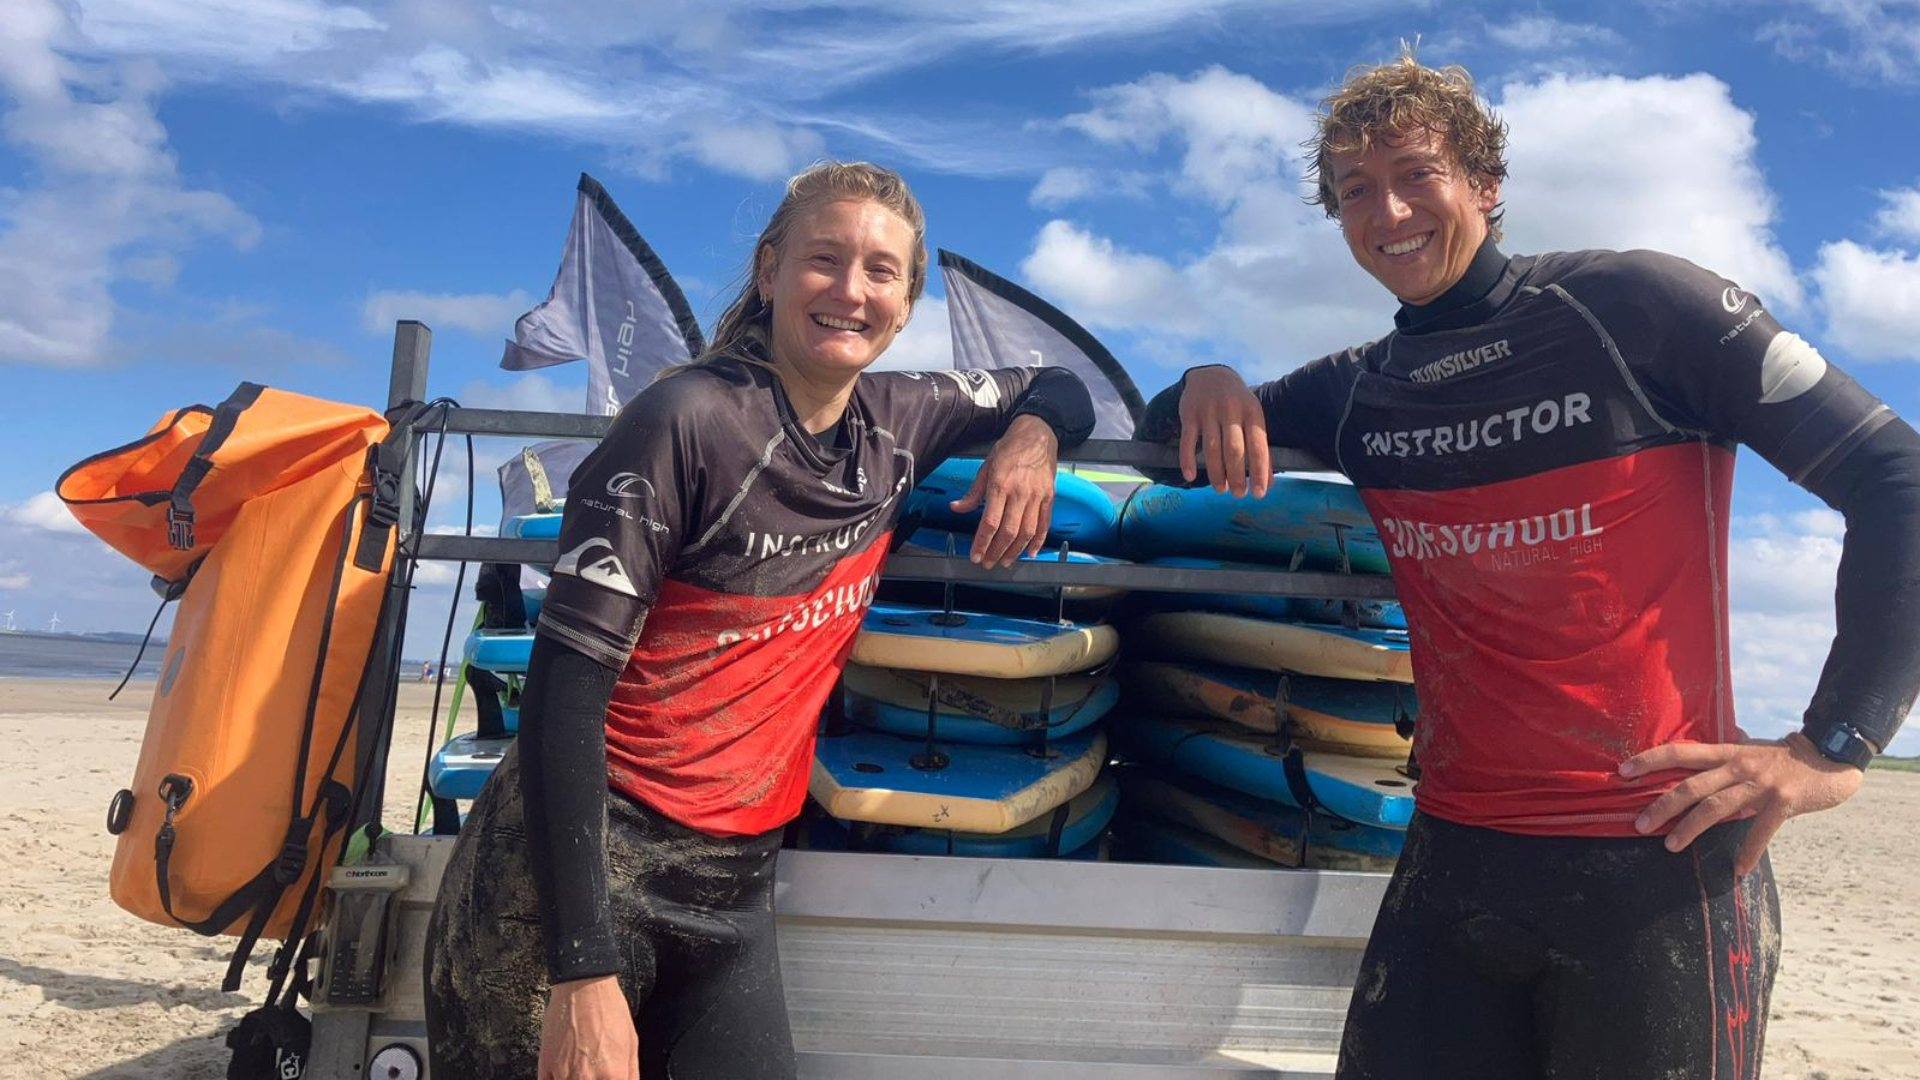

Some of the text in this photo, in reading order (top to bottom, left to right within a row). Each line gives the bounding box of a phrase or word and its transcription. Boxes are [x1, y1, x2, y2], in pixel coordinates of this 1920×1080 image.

[1409, 339, 1512, 383] QUIKSILVER
[1362, 392, 1592, 457] INSTRUCTOR
[580, 498, 669, 533] natural high
[1490, 538, 1603, 572] NATURAL HIGH
